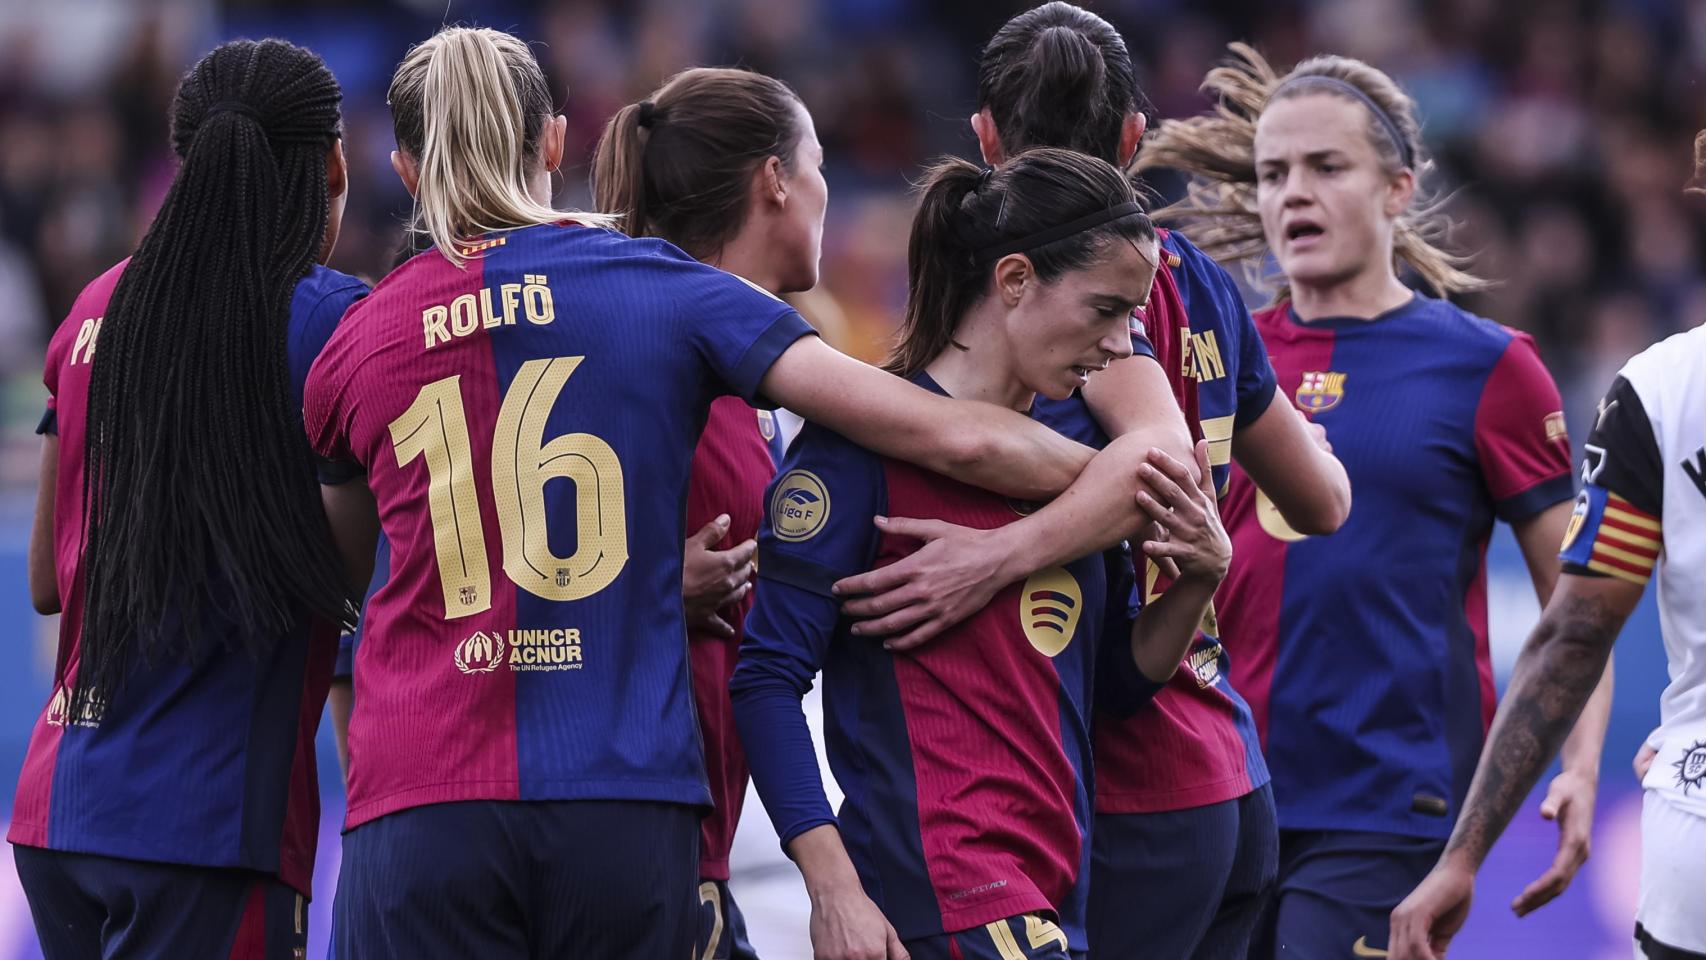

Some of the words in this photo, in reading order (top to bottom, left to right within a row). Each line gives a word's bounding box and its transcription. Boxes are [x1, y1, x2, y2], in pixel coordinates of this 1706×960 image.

[422, 274, 555, 349] ROLFÖ
[388, 356, 630, 620] 16
[804, 509, 814, 521] F
[508, 628, 581, 646] UNHCR
[508, 645, 582, 664] ACNUR
[531, 664, 557, 672] Refugee
[557, 663, 583, 671] Agency
